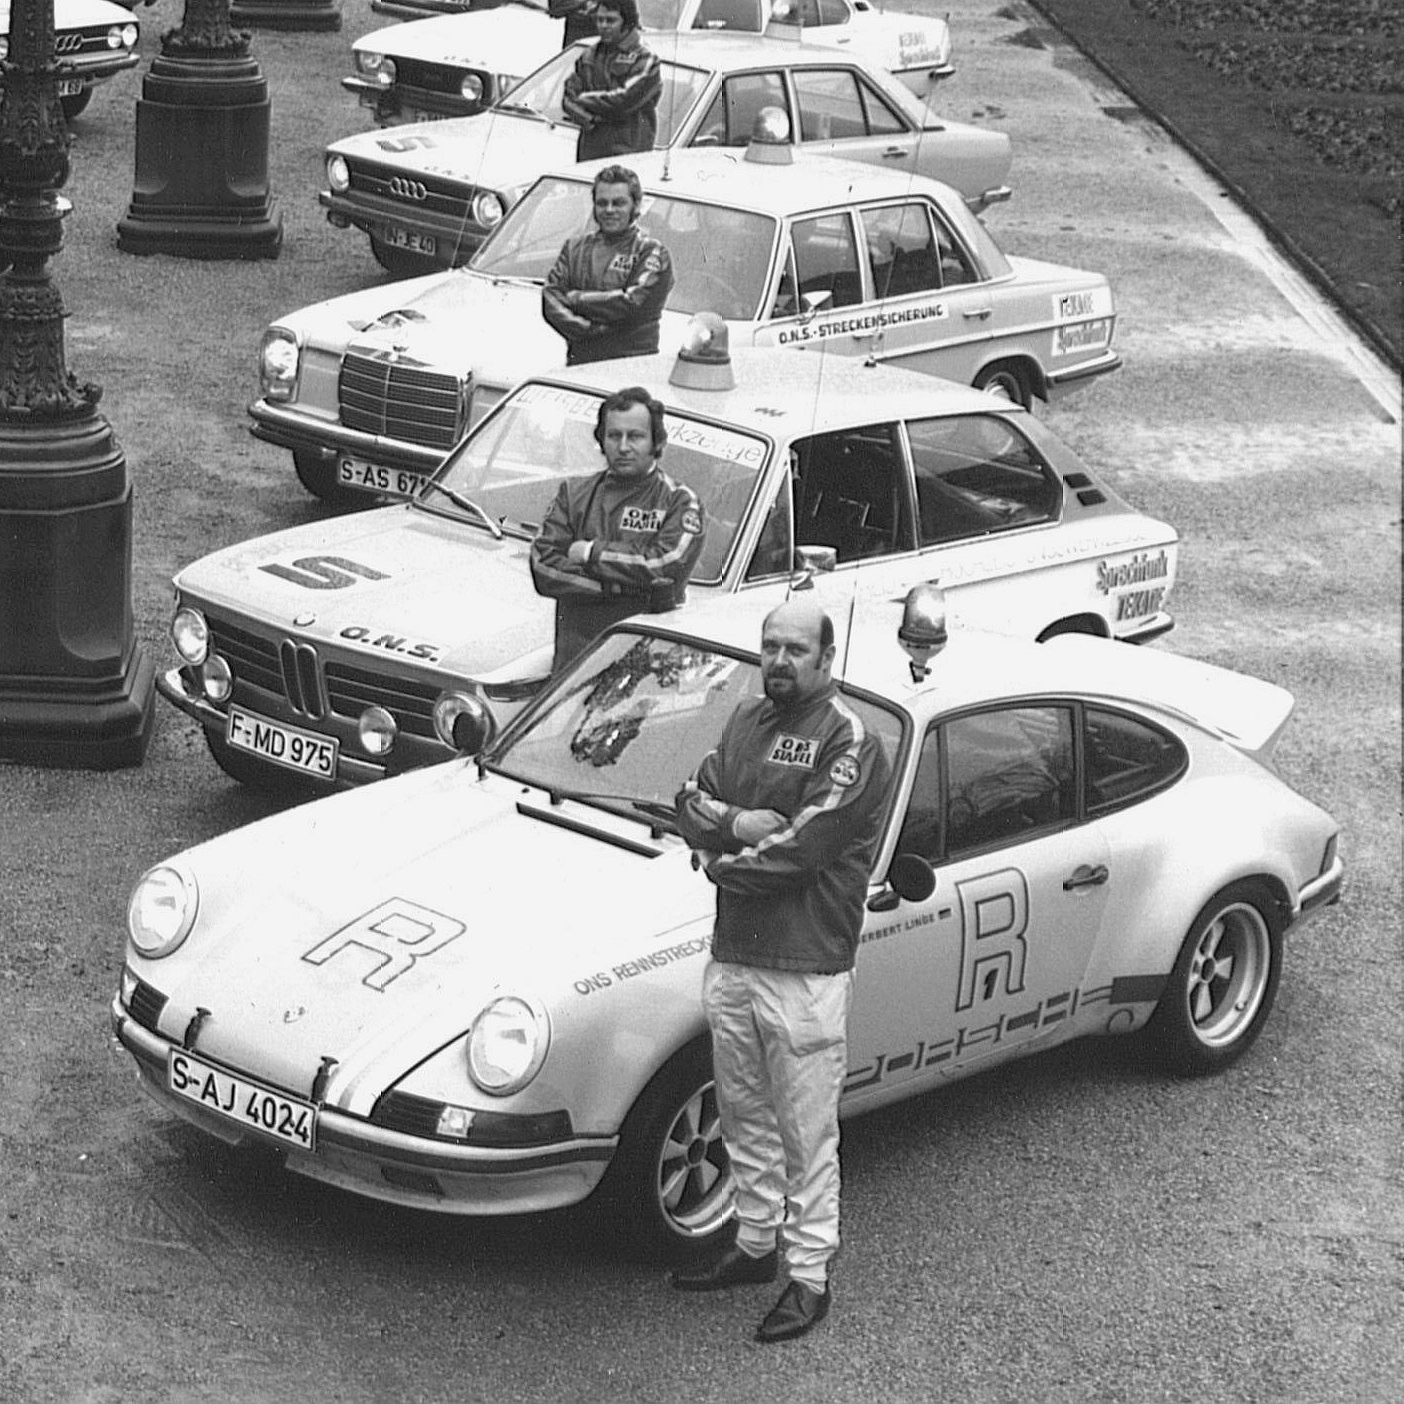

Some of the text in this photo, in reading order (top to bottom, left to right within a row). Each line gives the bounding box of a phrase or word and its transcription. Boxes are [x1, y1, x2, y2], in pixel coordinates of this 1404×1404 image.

[342, 460, 390, 489] S-AS
[230, 719, 333, 774] F-MD 975
[301, 896, 468, 993] R
[861, 923, 903, 943] ERBERT
[954, 866, 1029, 1012] R
[573, 972, 613, 996] ONS
[171, 1060, 310, 1143] S-AJ 4024
